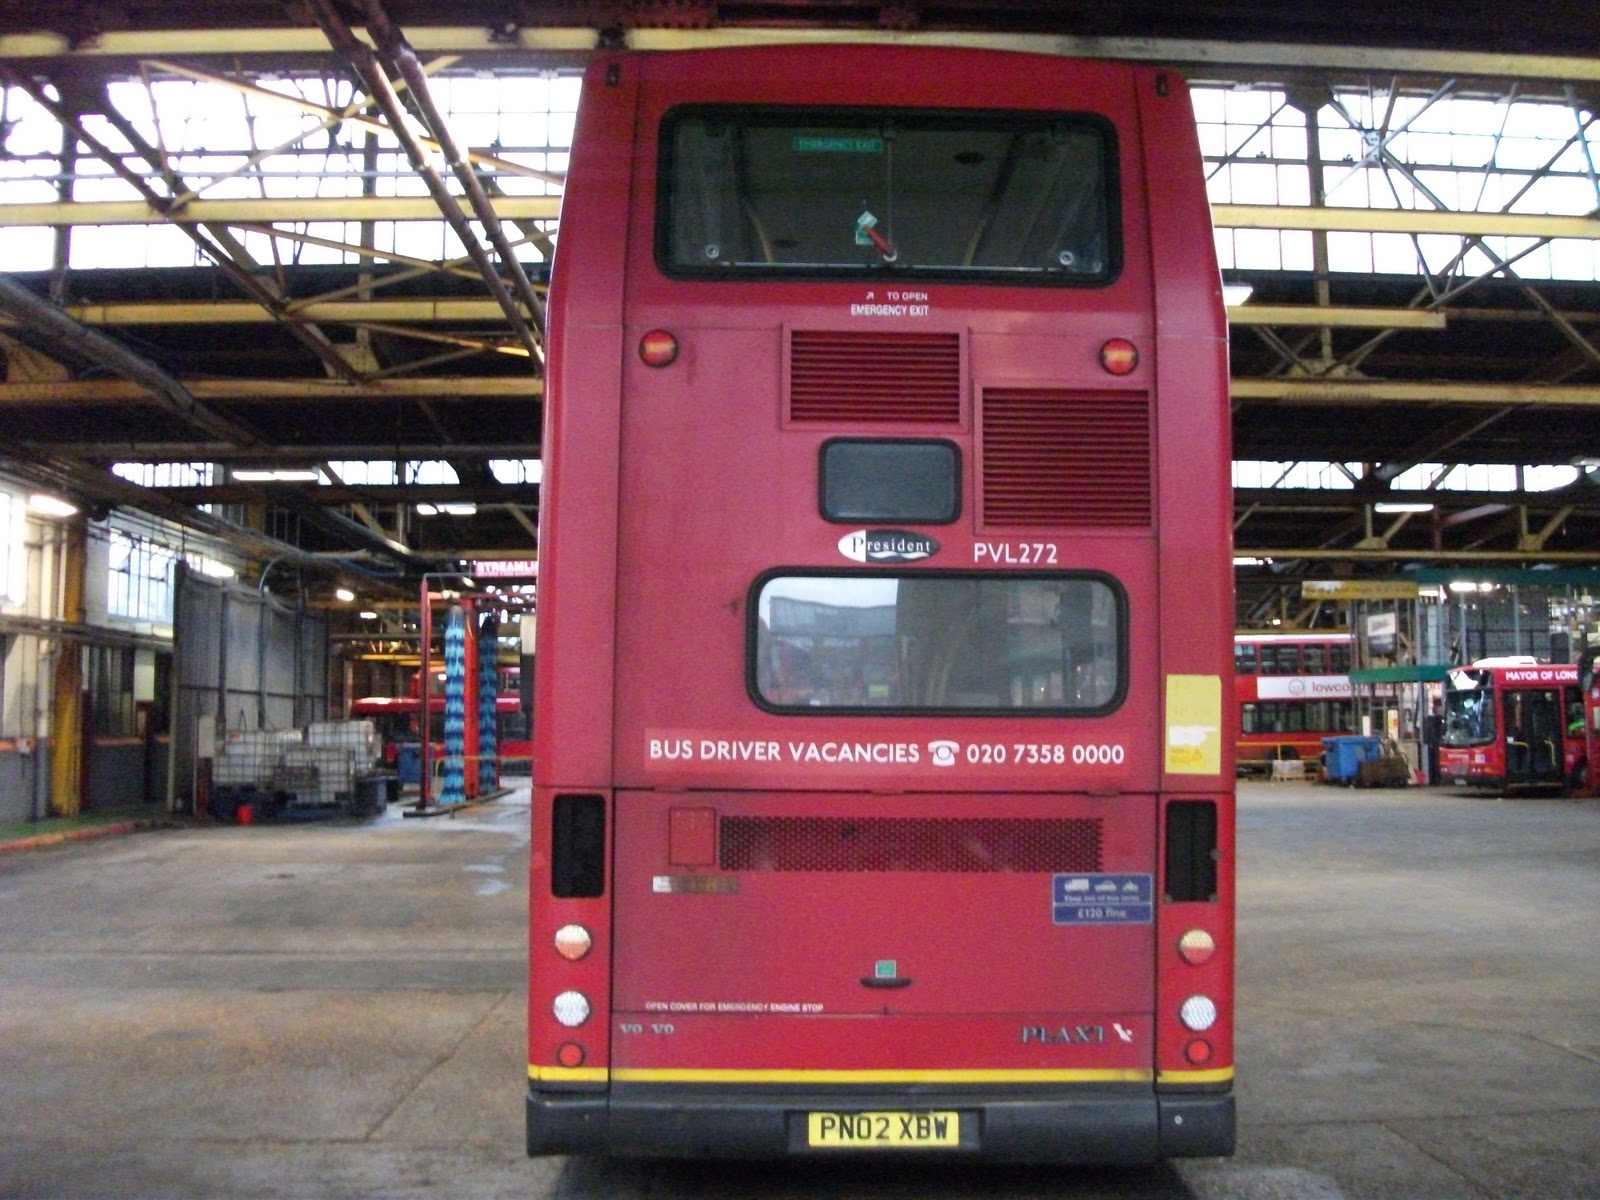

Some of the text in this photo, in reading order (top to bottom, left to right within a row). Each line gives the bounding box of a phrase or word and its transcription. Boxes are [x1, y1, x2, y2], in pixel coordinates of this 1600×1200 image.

[887, 291, 928, 301] TO OPEN
[851, 304, 929, 316] EMERGENCY EXIT
[852, 536, 931, 553] President
[973, 543, 1058, 563] PVL272
[1505, 671, 1538, 681] MAYOR
[1540, 671, 1553, 680] OF
[650, 739, 1125, 765] BUS DRIVER VACANCIES 020 7358 0000
[645, 1001, 824, 1013] OPEN COVER FOR EMERGENCY ENGINE STOP
[820, 1116, 949, 1140] PN02 XBW
